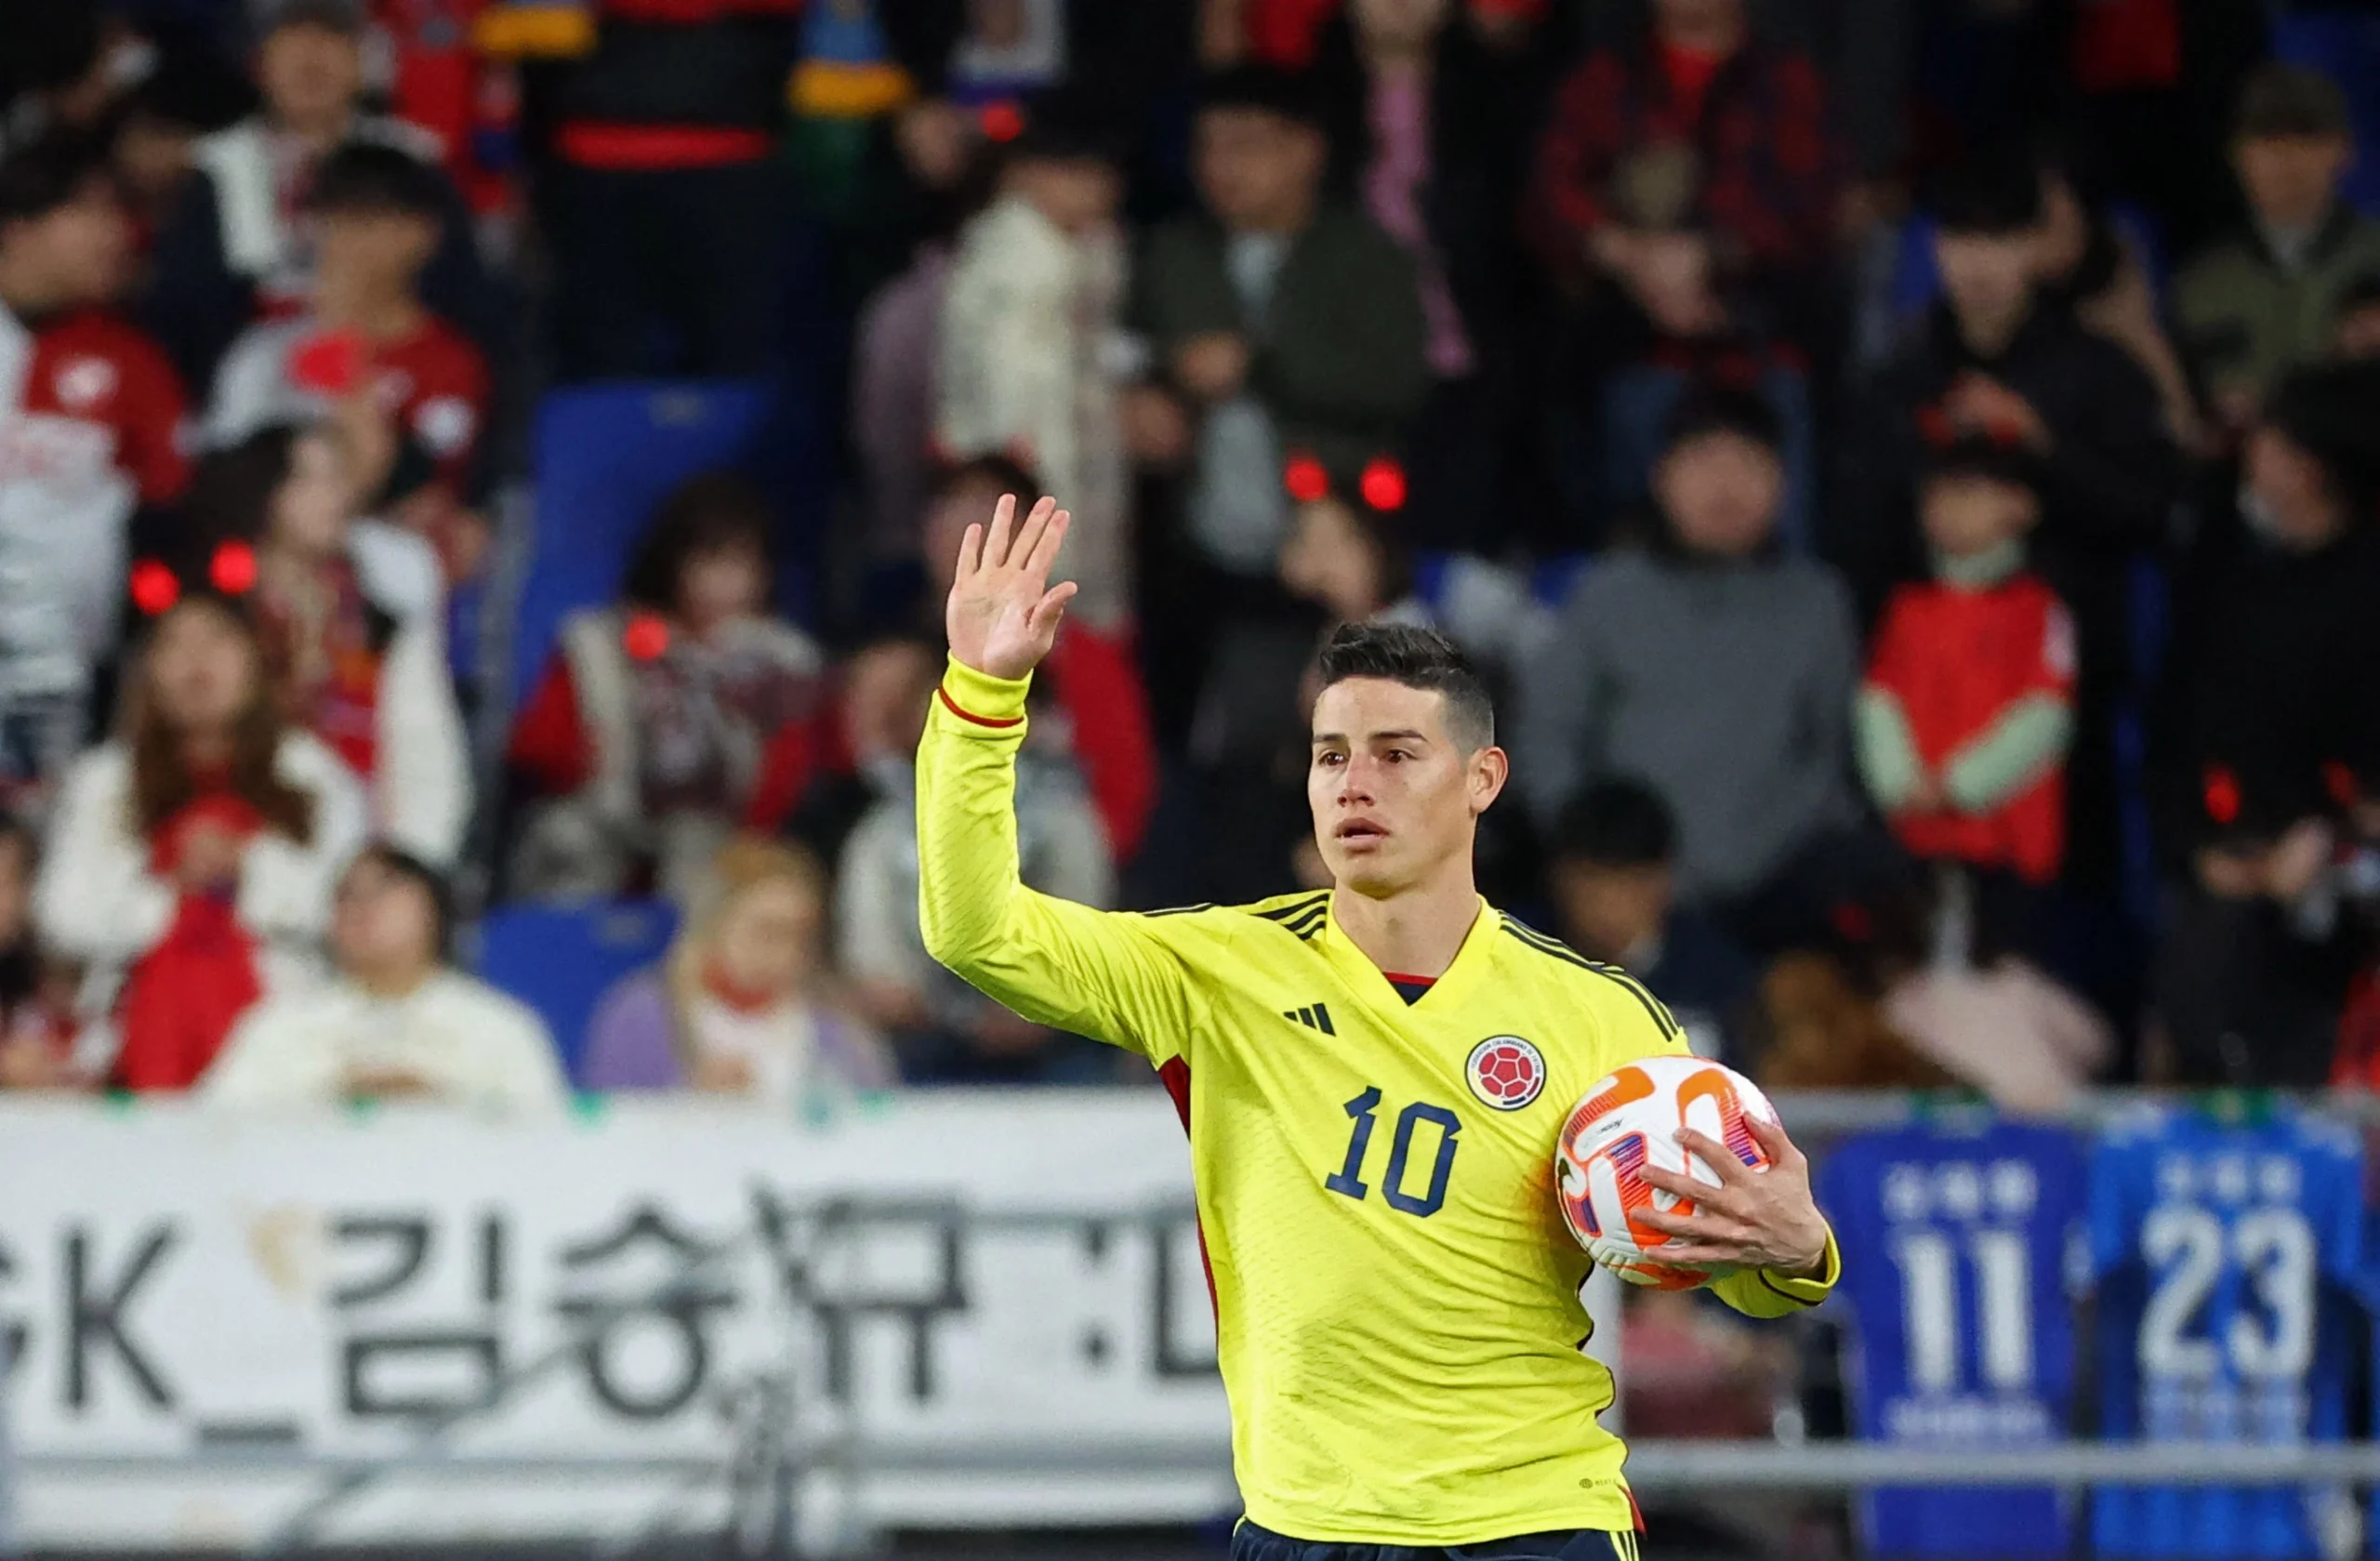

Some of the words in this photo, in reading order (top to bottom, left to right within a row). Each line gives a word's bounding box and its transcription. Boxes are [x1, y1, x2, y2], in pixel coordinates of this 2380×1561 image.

[1325, 1085, 1462, 1218] 10
[0, 1194, 969, 1445] K_김승규
[1897, 1227, 2030, 1392] 11
[2139, 1206, 2315, 1376] 23
